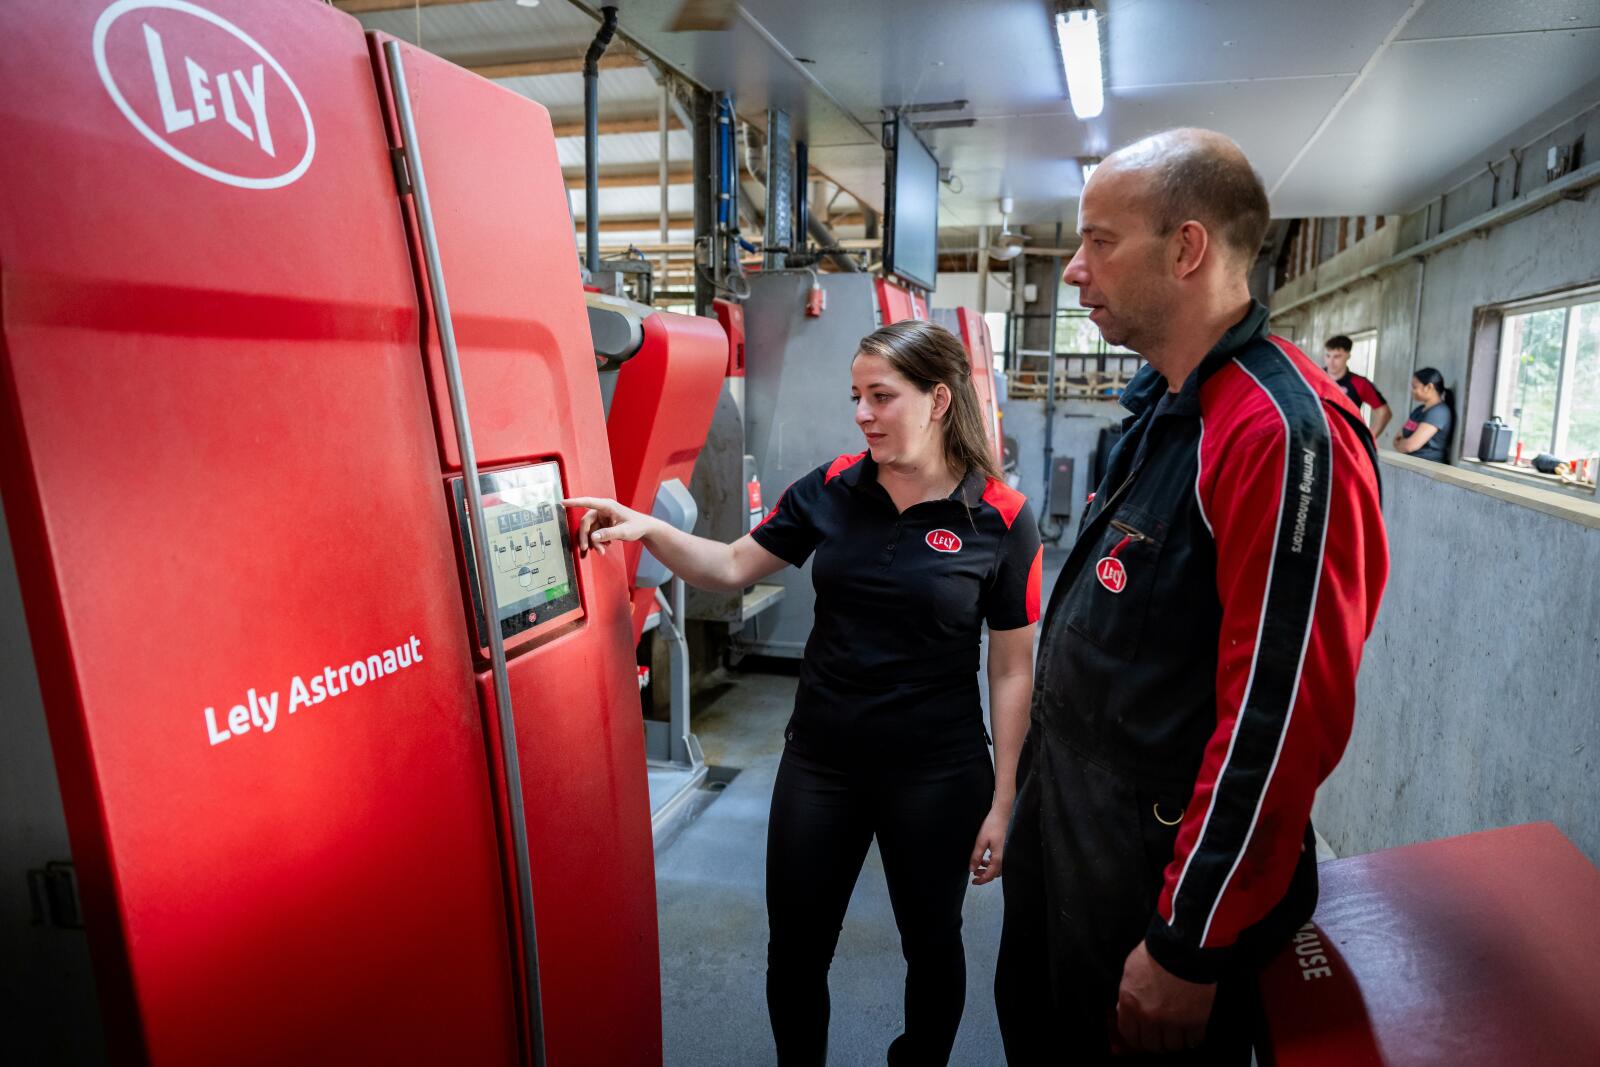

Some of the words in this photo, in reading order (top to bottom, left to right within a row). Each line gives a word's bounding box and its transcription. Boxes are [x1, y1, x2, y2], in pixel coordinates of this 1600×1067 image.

[142, 22, 276, 158] LELY
[1299, 447, 1316, 494] farming
[932, 532, 955, 549] LELY
[1291, 497, 1312, 553] innovators
[1102, 560, 1123, 588] LELY
[204, 688, 279, 746] Lely
[288, 635, 423, 714] Astronaut
